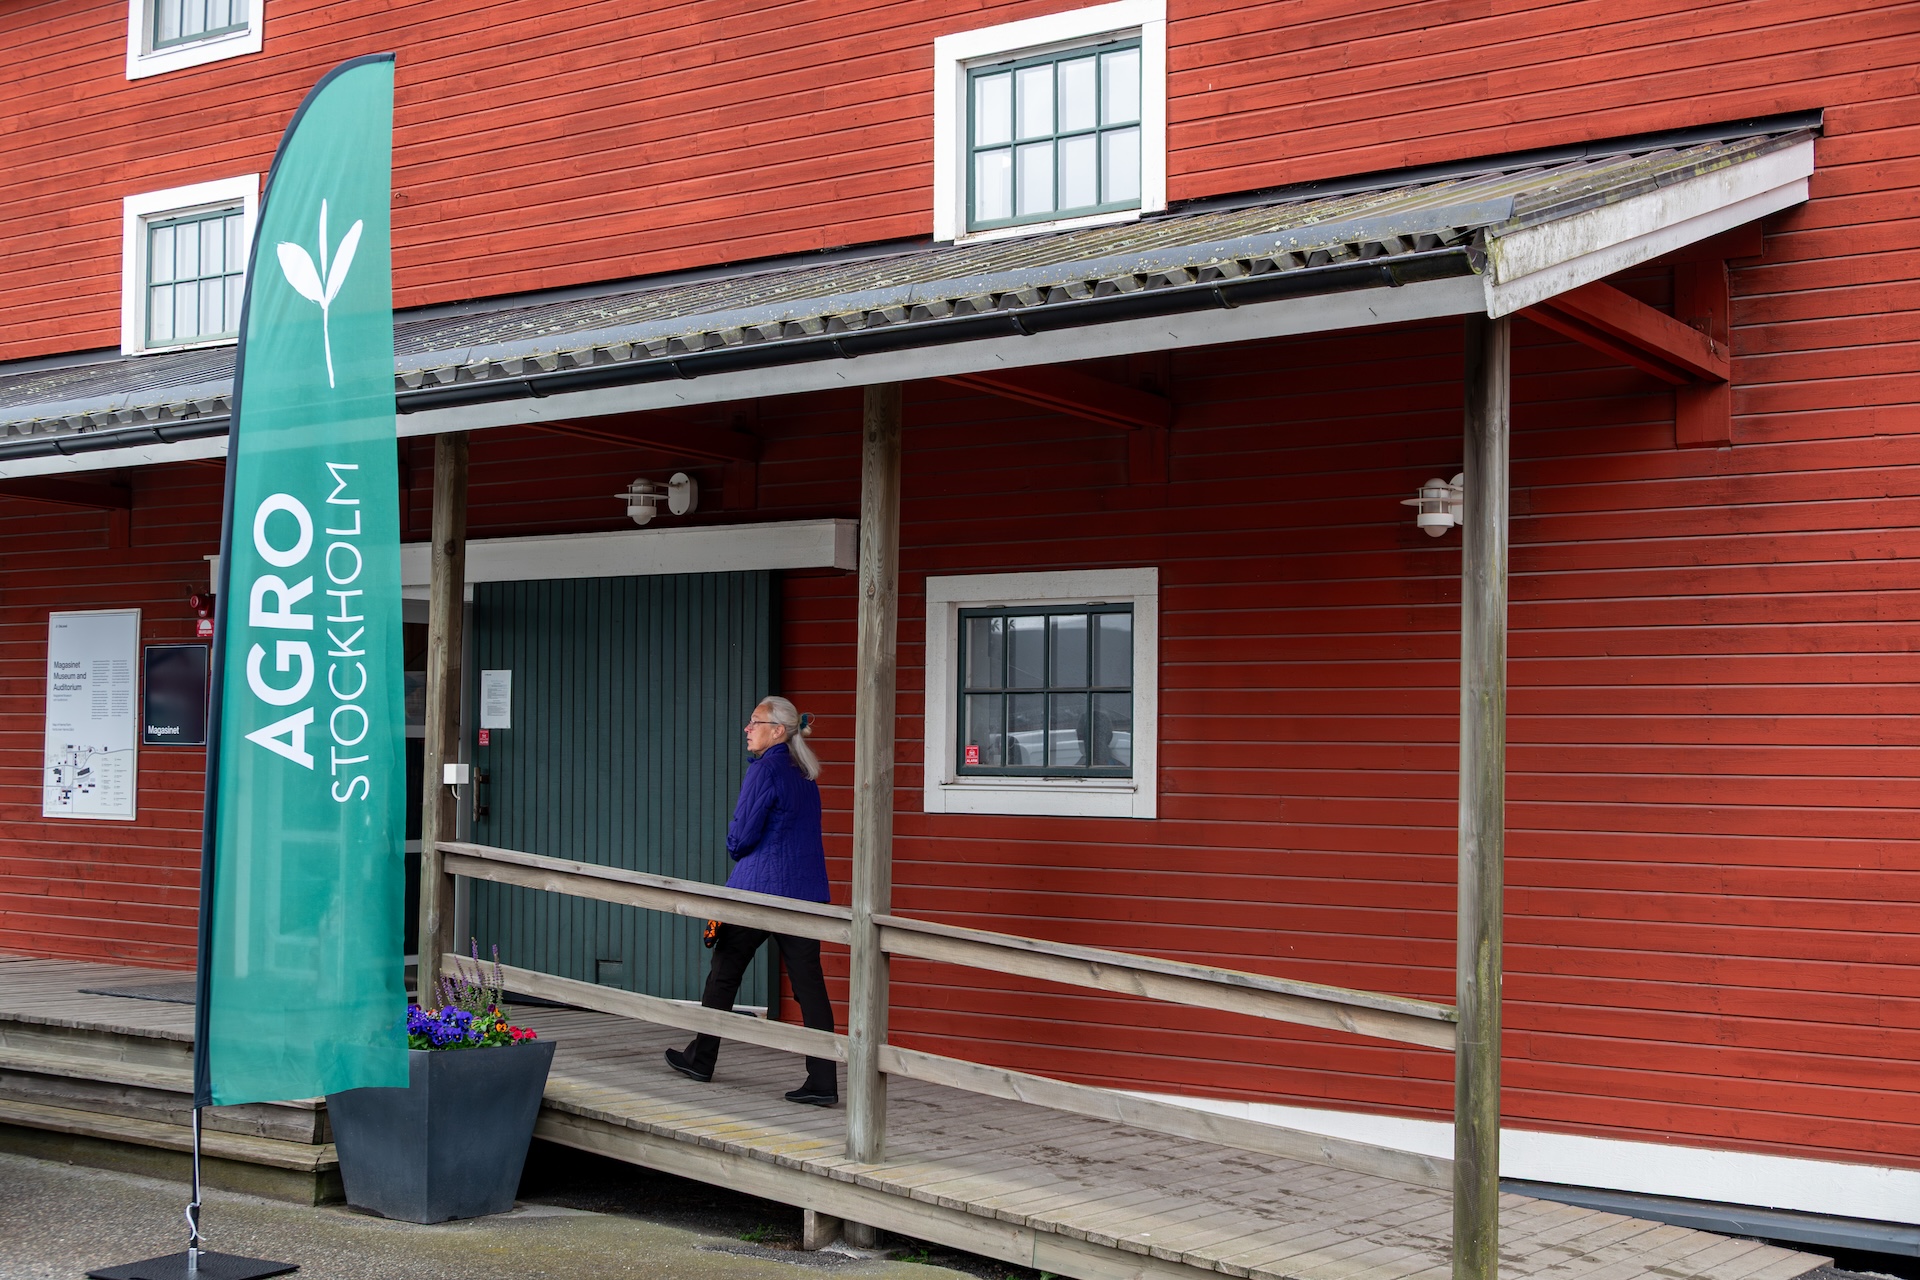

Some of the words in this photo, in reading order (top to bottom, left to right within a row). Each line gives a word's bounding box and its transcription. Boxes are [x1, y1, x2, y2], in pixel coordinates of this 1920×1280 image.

[244, 493, 315, 770] AGRO
[325, 461, 370, 803] STOCKHOLM
[54, 661, 81, 670] Magasinet
[53, 672, 75, 680] Museum
[76, 672, 87, 680] and
[147, 725, 180, 736] Magasinet
